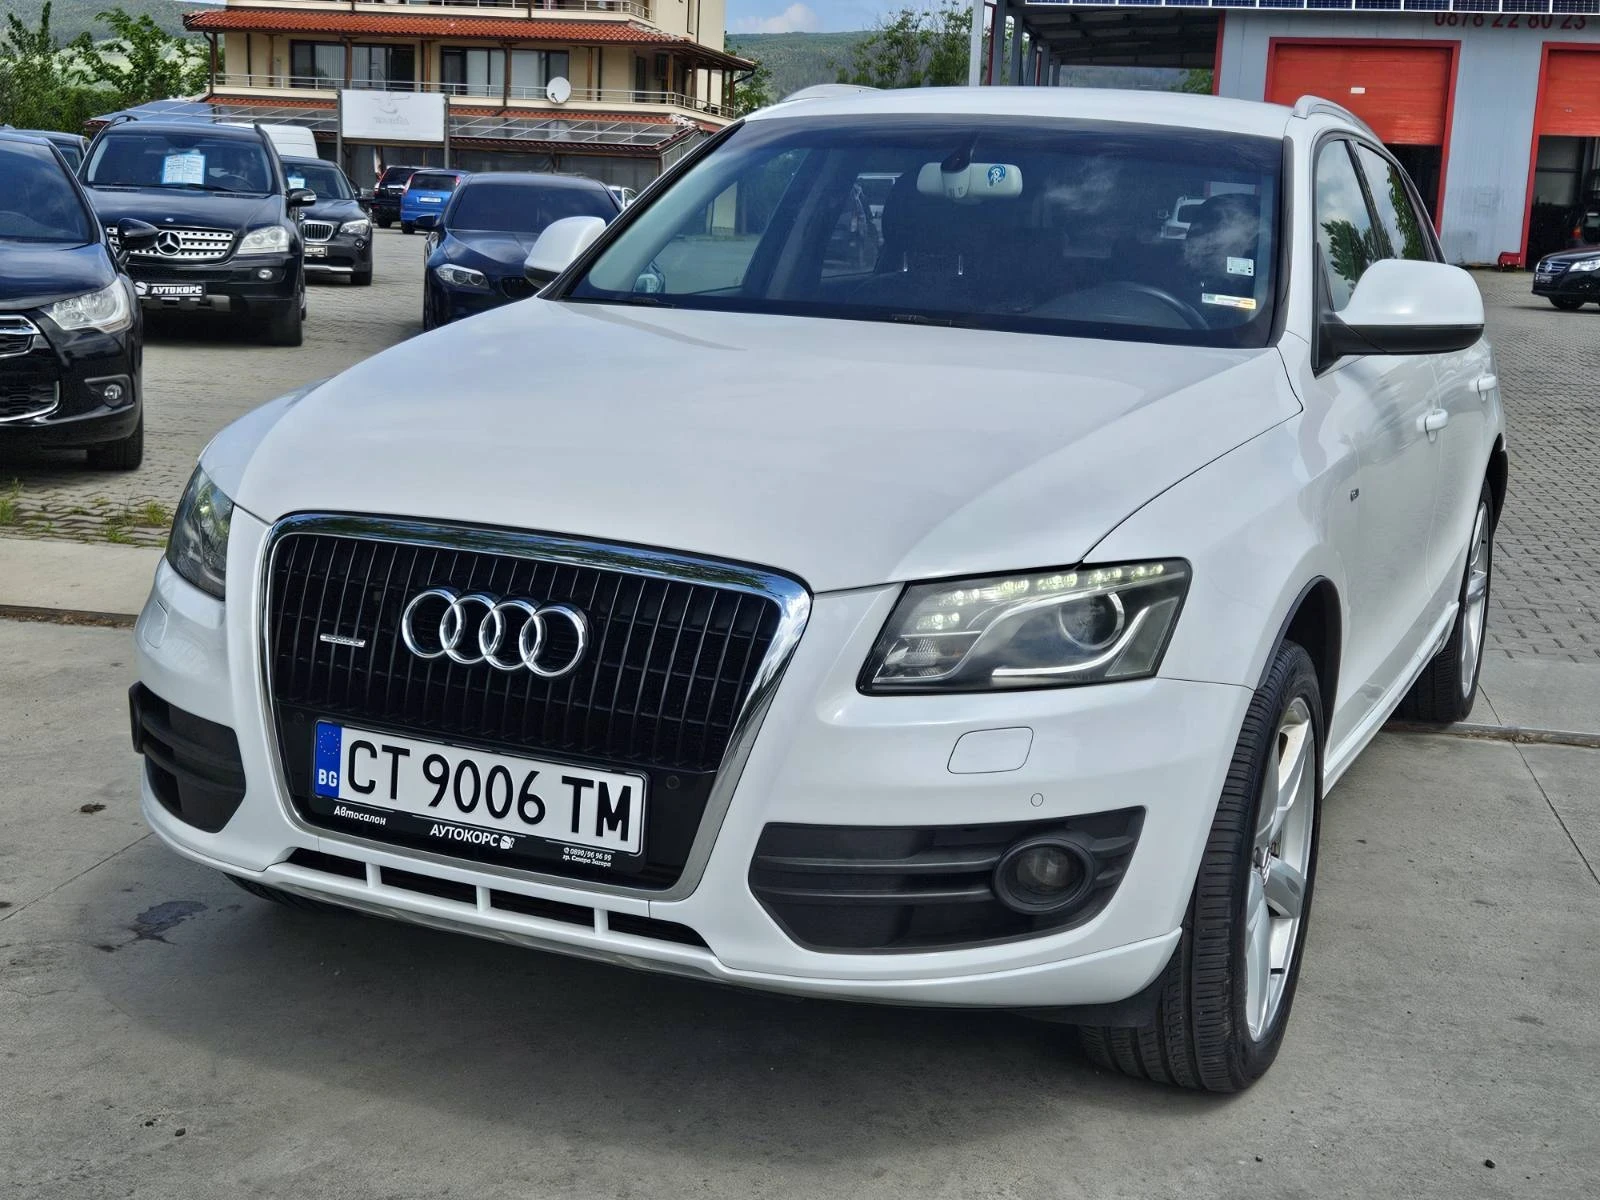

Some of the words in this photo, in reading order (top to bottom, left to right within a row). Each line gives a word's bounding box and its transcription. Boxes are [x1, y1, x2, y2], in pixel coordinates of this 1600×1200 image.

[151, 285, 202, 295] АУТОКОРС
[318, 768, 338, 787] BG
[348, 739, 410, 800] CT
[422, 753, 546, 825] 9006
[561, 775, 632, 841] TM
[333, 805, 387, 826] Автосалон
[429, 823, 500, 847] АУТОКОРС
